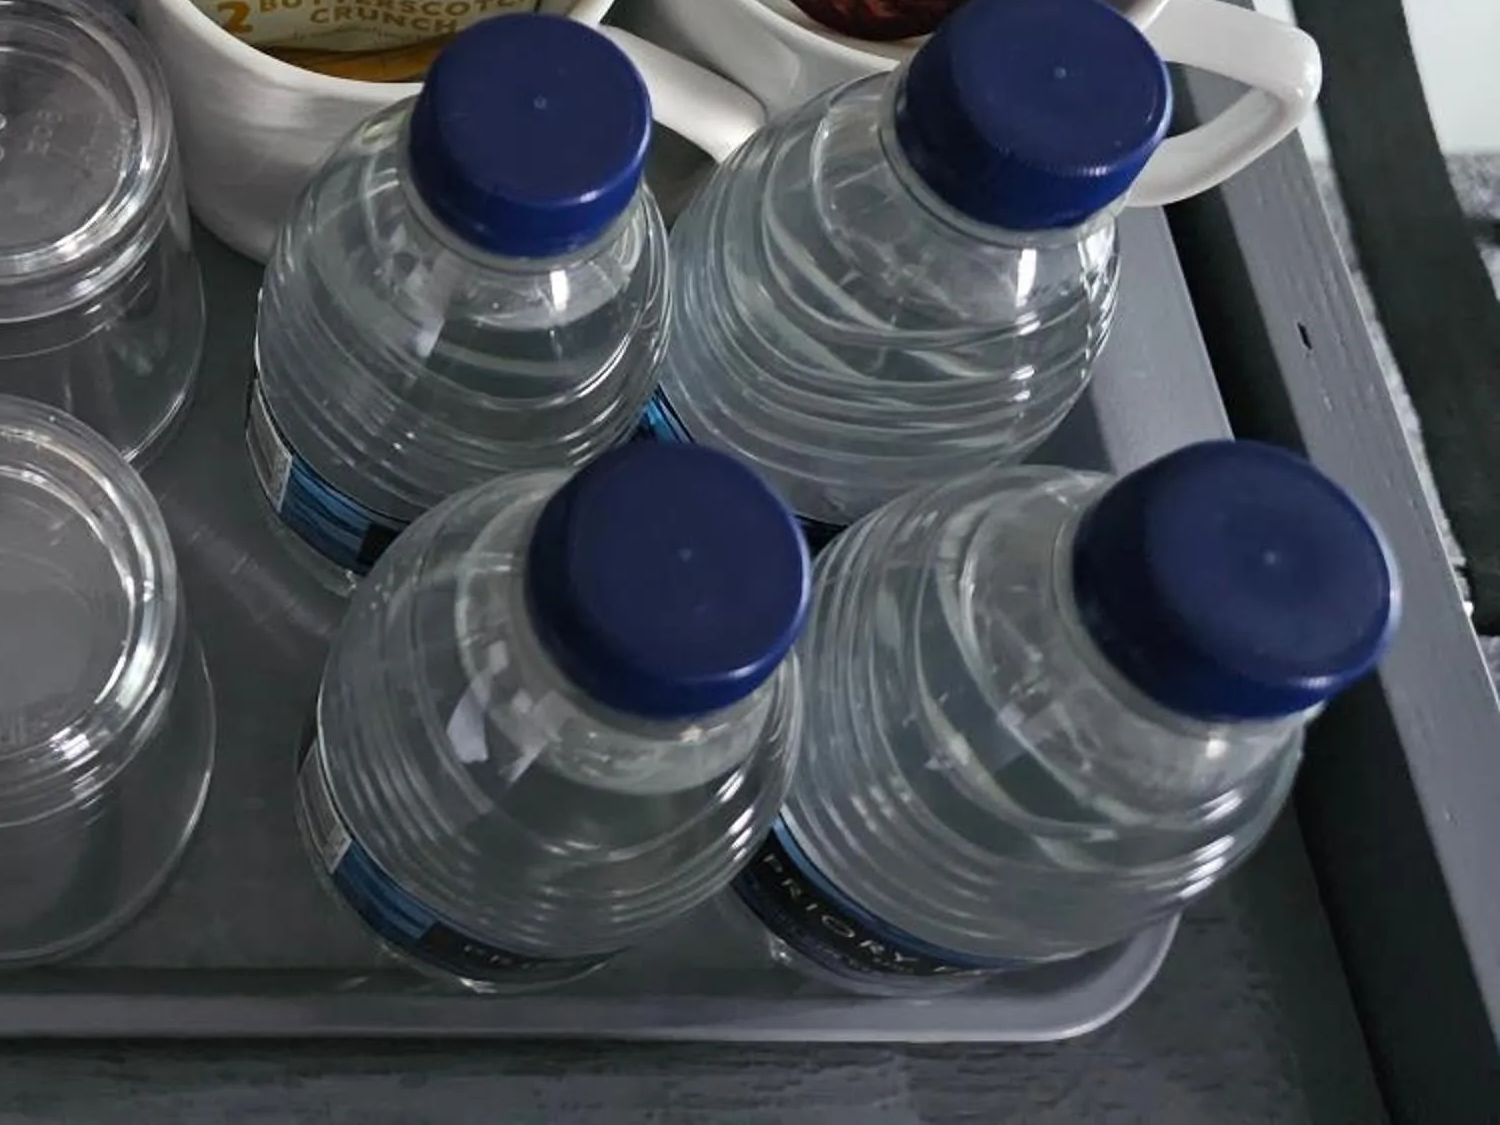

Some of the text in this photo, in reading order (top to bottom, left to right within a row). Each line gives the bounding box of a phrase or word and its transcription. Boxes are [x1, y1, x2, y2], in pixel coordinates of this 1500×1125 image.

[217, 0, 253, 34] 2
[310, 7, 457, 33] CRUNCH
[764, 852, 920, 963] PRIORY
